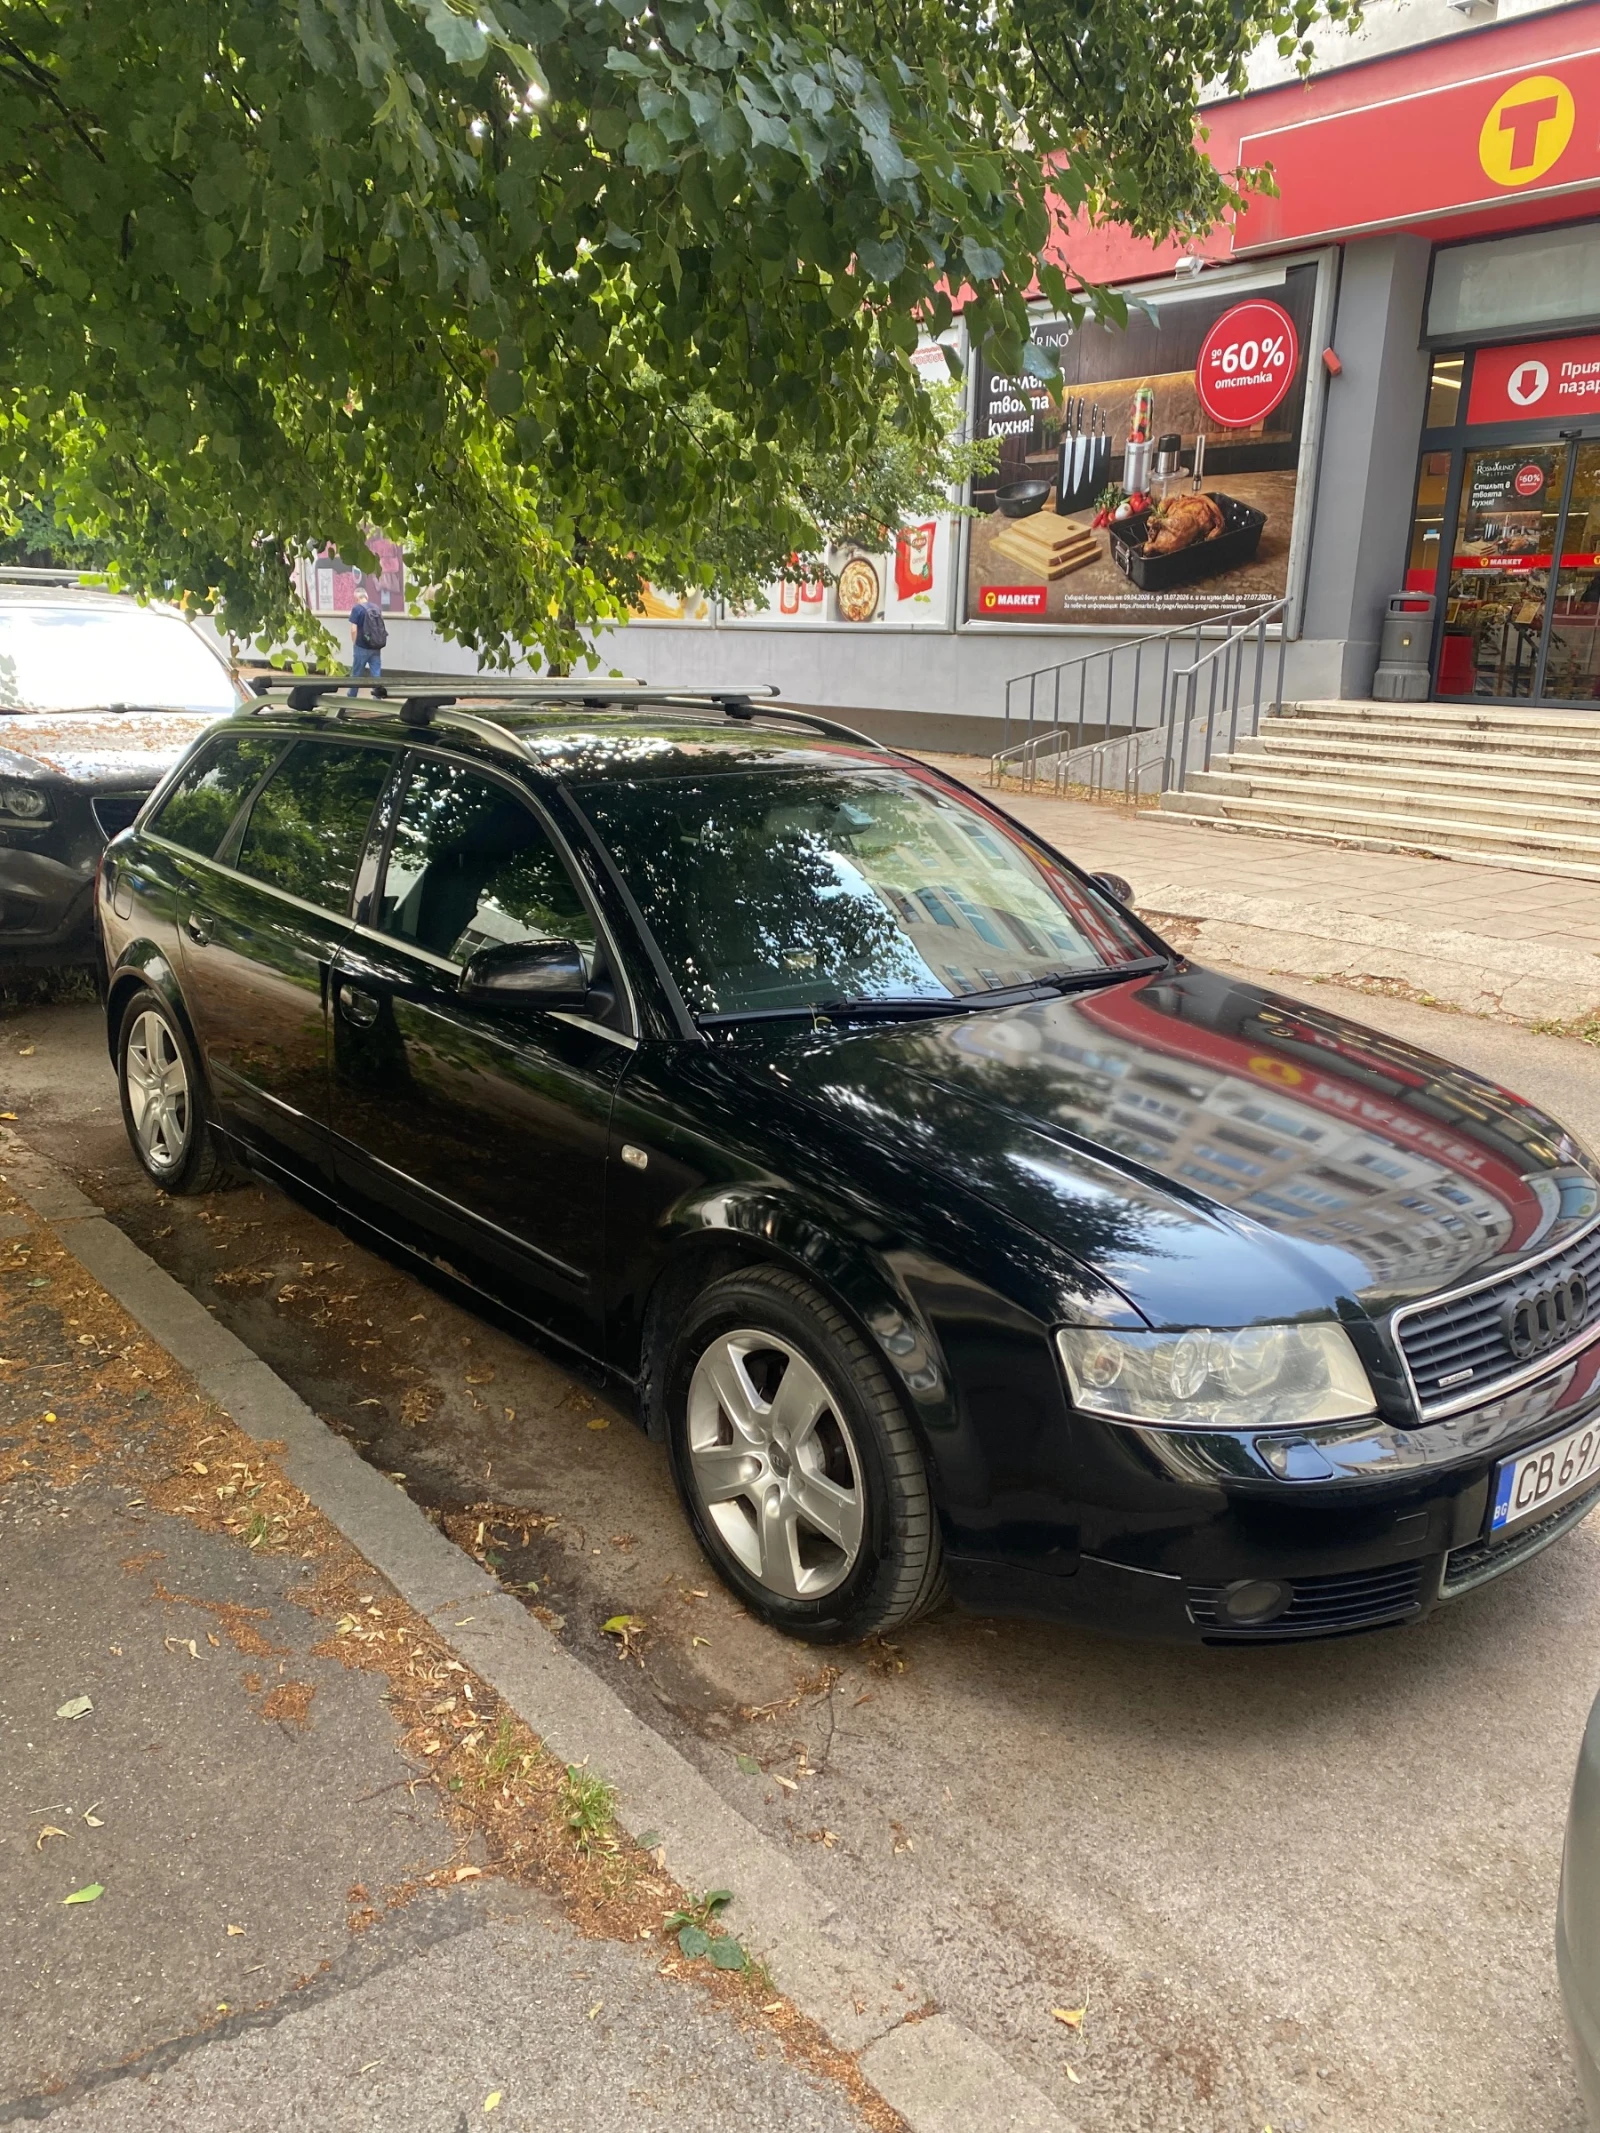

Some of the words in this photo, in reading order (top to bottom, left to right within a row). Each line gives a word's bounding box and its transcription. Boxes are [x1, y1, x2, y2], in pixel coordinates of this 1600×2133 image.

[1211, 335, 1285, 374] -60%
[1215, 371, 1273, 390] отстъпка
[988, 414, 1035, 437] кухня!
[1472, 499, 1494, 508] кухня!
[998, 594, 1040, 605] MARKET
[1516, 1451, 1555, 1510] CB
[1494, 1502, 1508, 1520] BG
